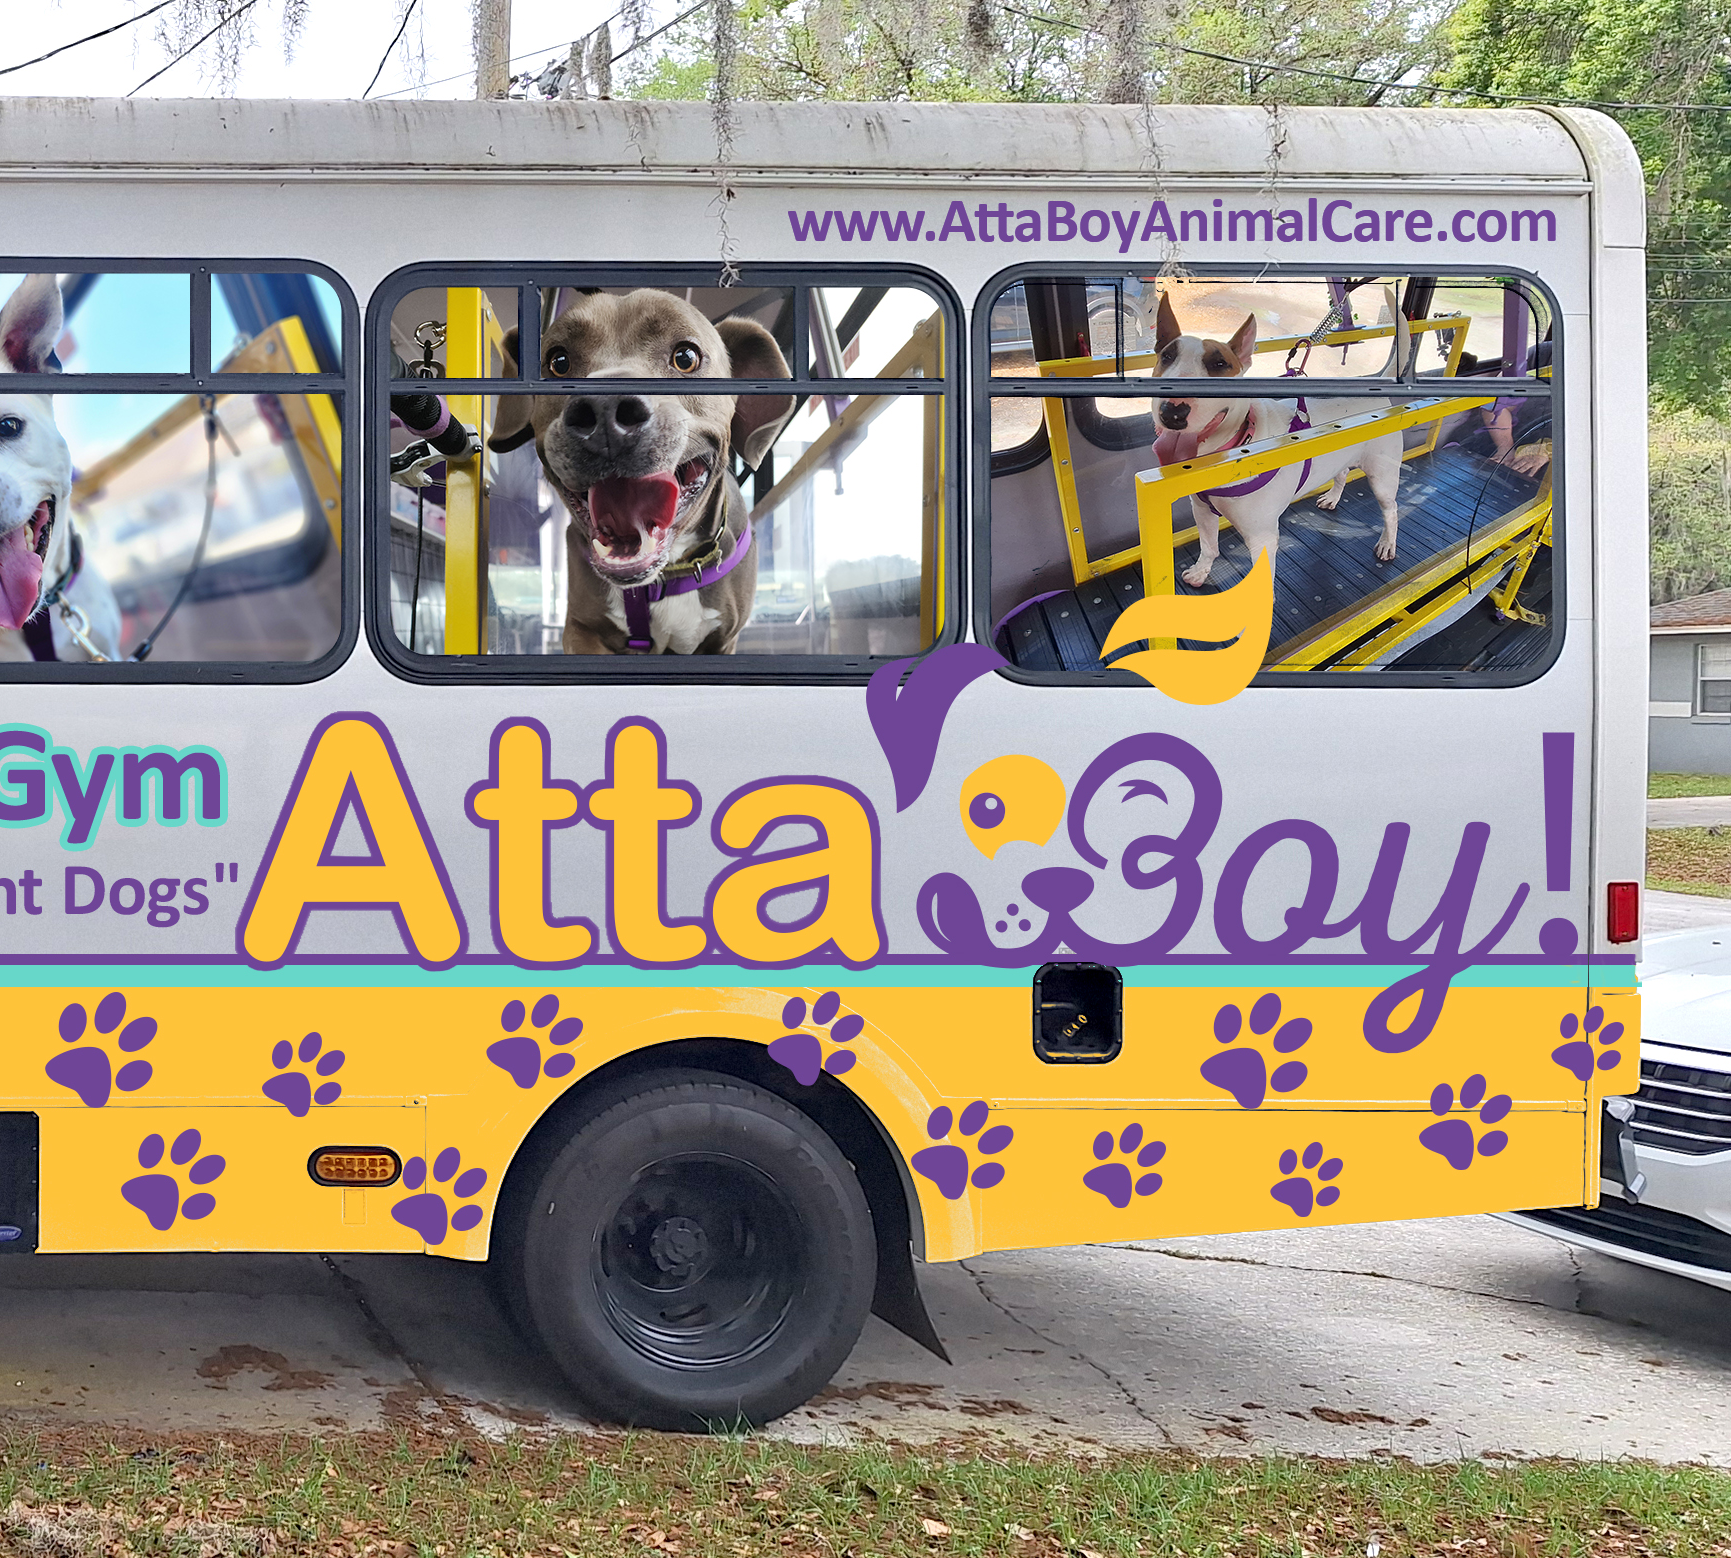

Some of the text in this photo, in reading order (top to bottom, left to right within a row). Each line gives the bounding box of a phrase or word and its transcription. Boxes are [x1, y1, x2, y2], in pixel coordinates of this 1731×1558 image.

[788, 197, 1557, 252] www.AttaBoyAnimalCare.com
[64, 862, 241, 928] Dogs"
[236, 711, 1579, 1054] Atta Boy!
